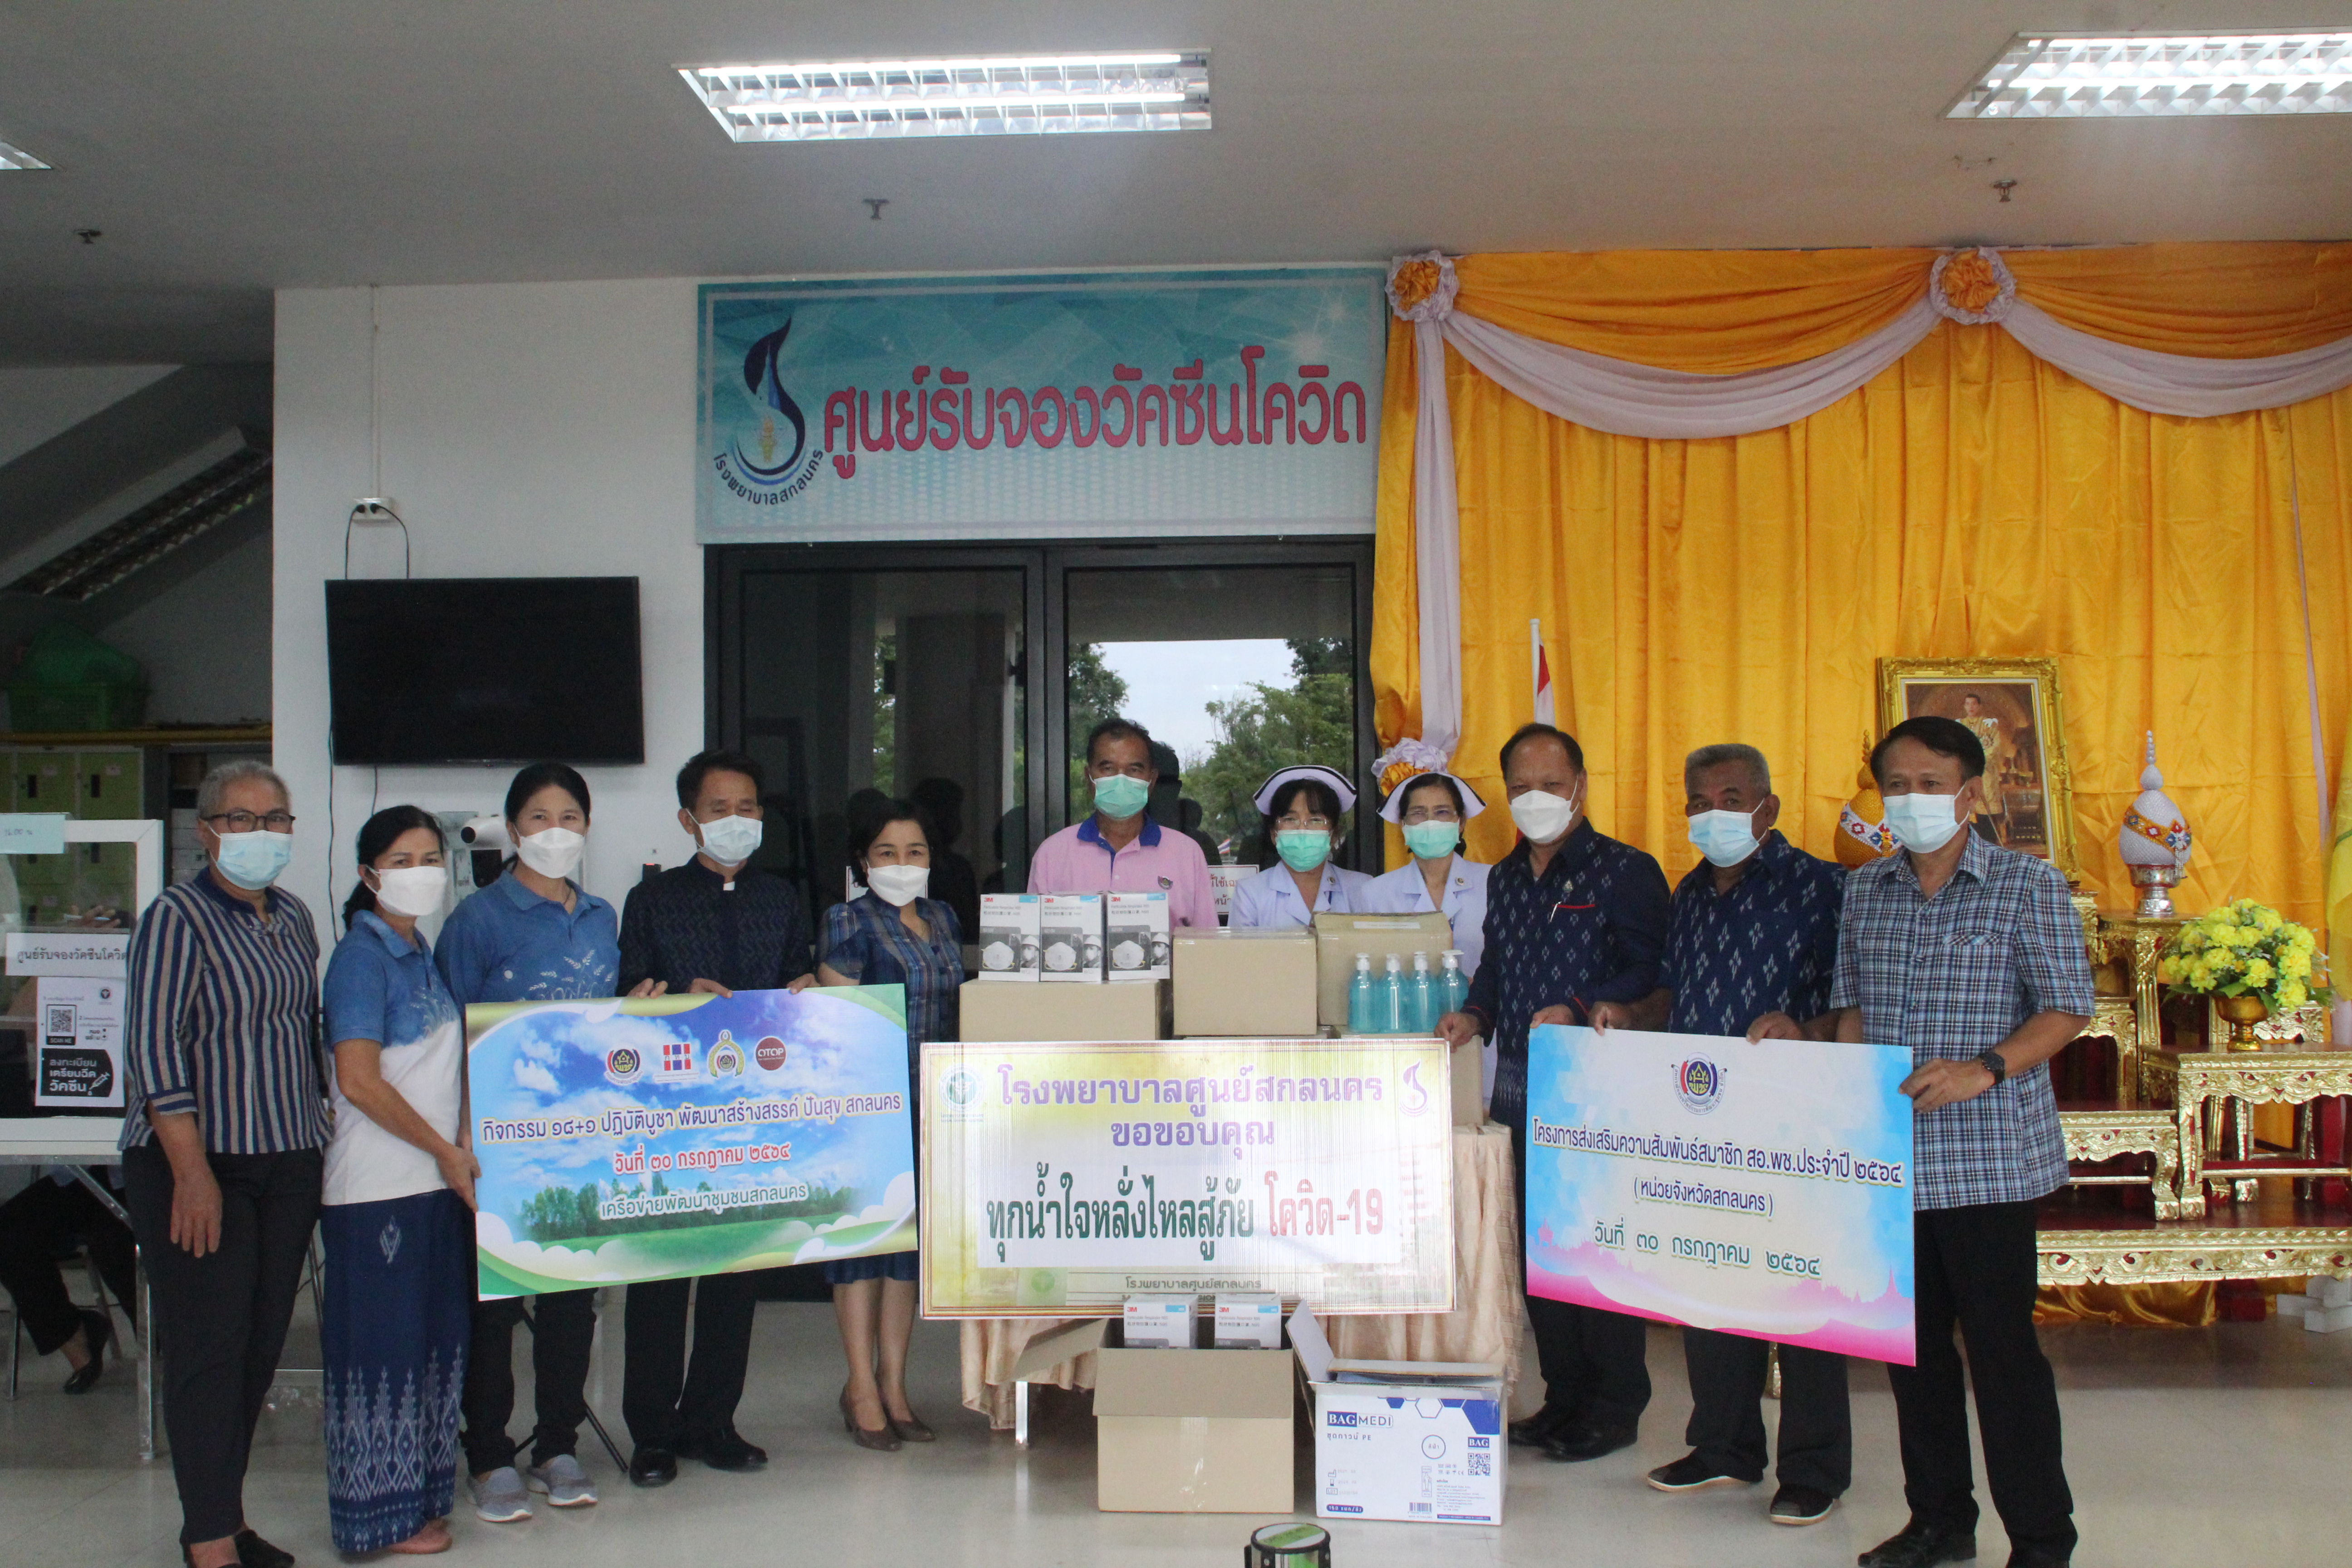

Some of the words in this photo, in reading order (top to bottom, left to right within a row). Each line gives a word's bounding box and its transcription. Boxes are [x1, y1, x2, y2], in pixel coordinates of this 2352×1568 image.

[823, 345, 1366, 479] ศูนย์รับจองวัคซีนโควิด
[714, 450, 823, 505] โรงพยาบาลสกลนคร
[758, 1048, 784, 1057] OTOP
[49, 1079, 87, 1092] วัคซีน
[997, 1064, 1382, 1117] โรงพยาบาลศูนย์สกลนคร
[483, 1121, 546, 1141] กิจกรรม
[601, 1109, 674, 1136] ปฏิบัติบูชา
[679, 1096, 798, 1126] พัฒนาสร้างสรรค์
[804, 1096, 841, 1121] ปันสุข
[846, 1095, 901, 1112] สกลนคร
[1111, 1121, 1275, 1160] ขอขอบคุณ
[615, 1146, 644, 1172] วันที่
[651, 1155, 671, 1170] ๓๐
[678, 1147, 743, 1169] กรกฎาคม
[750, 1143, 791, 1160] ๒๕๖๔
[1533, 1118, 1743, 1166] โครงการส่งเสริมความสัมพันธ์สมาชิก
[1854, 1160, 1901, 1183] ๒๕๖๔
[602, 1184, 807, 1217] เครือข่ายพัฒนาชุมชนสกลนคร
[986, 1161, 1254, 1263] ทุกน้ำใจหลั่งไหลสู้ภัย
[1264, 1170, 1383, 1238] โควิด-19
[1594, 1217, 1624, 1246] วันที่
[1637, 1233, 1658, 1250] ๓๐
[1672, 1236, 1750, 1264] กรกฎาคม
[1766, 1250, 1821, 1276] ๒๕๖๔
